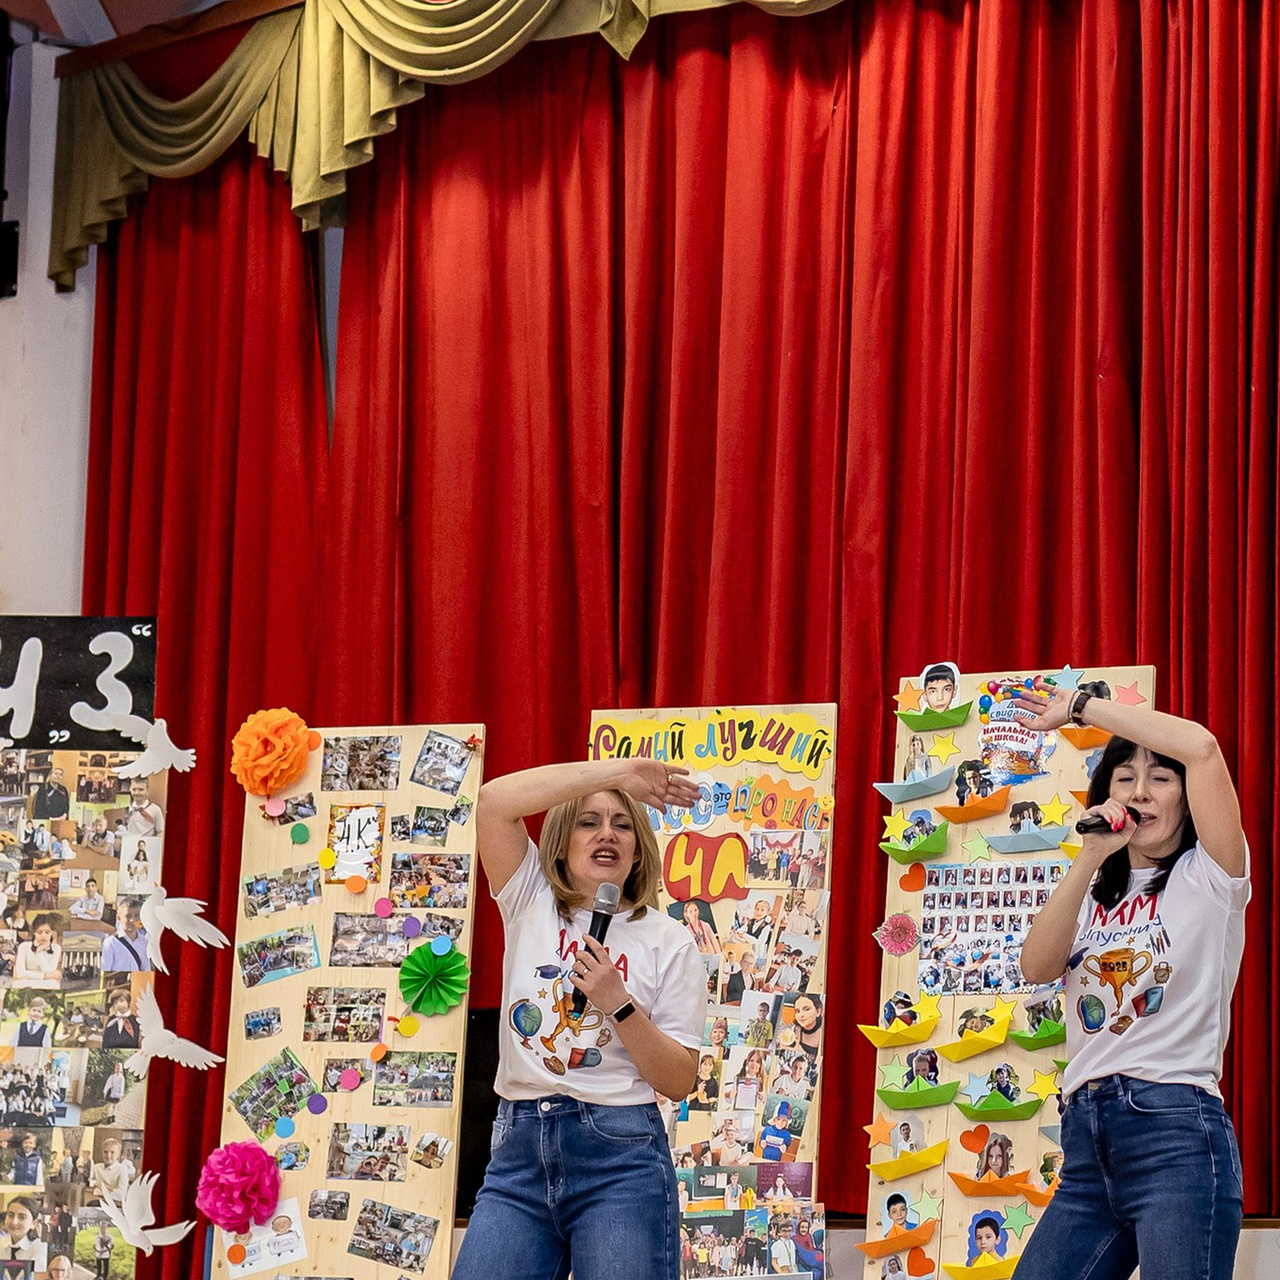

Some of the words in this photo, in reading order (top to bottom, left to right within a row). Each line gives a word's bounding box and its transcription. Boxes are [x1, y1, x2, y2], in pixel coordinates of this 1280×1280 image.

[983, 726, 1037, 740] НАЧАЛЬНАЯ
[994, 734, 1028, 745] ШКОЛА!
[734, 785, 777, 821] ПРО
[1101, 961, 1127, 972] 2025
